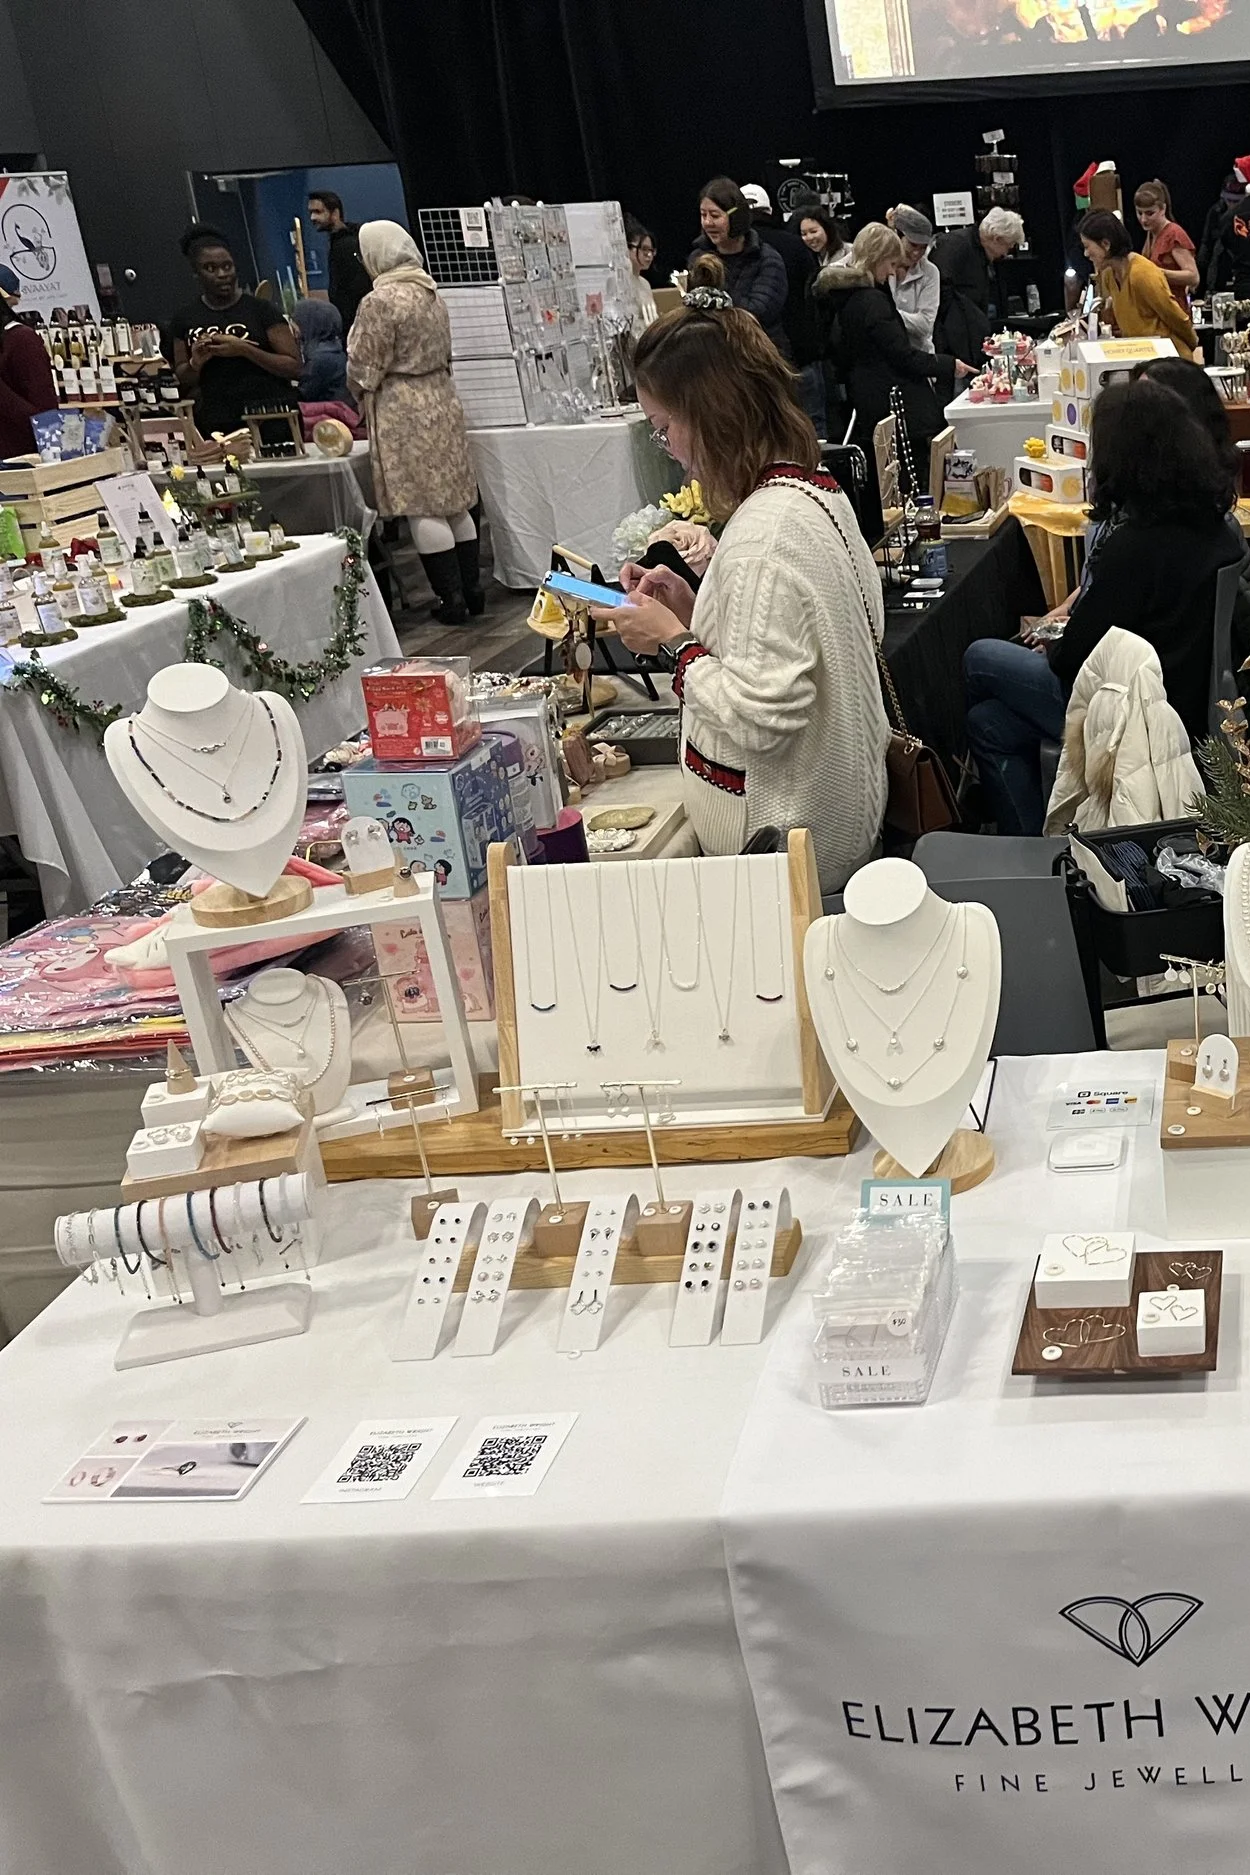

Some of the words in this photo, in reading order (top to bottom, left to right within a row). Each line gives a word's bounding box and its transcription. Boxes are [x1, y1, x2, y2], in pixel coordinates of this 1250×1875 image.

[879, 1193, 934, 1207] SALE
[841, 1365, 892, 1377] SALE
[842, 1697, 1165, 1747] ELIZABETH
[955, 1774, 1049, 1793] FINE
